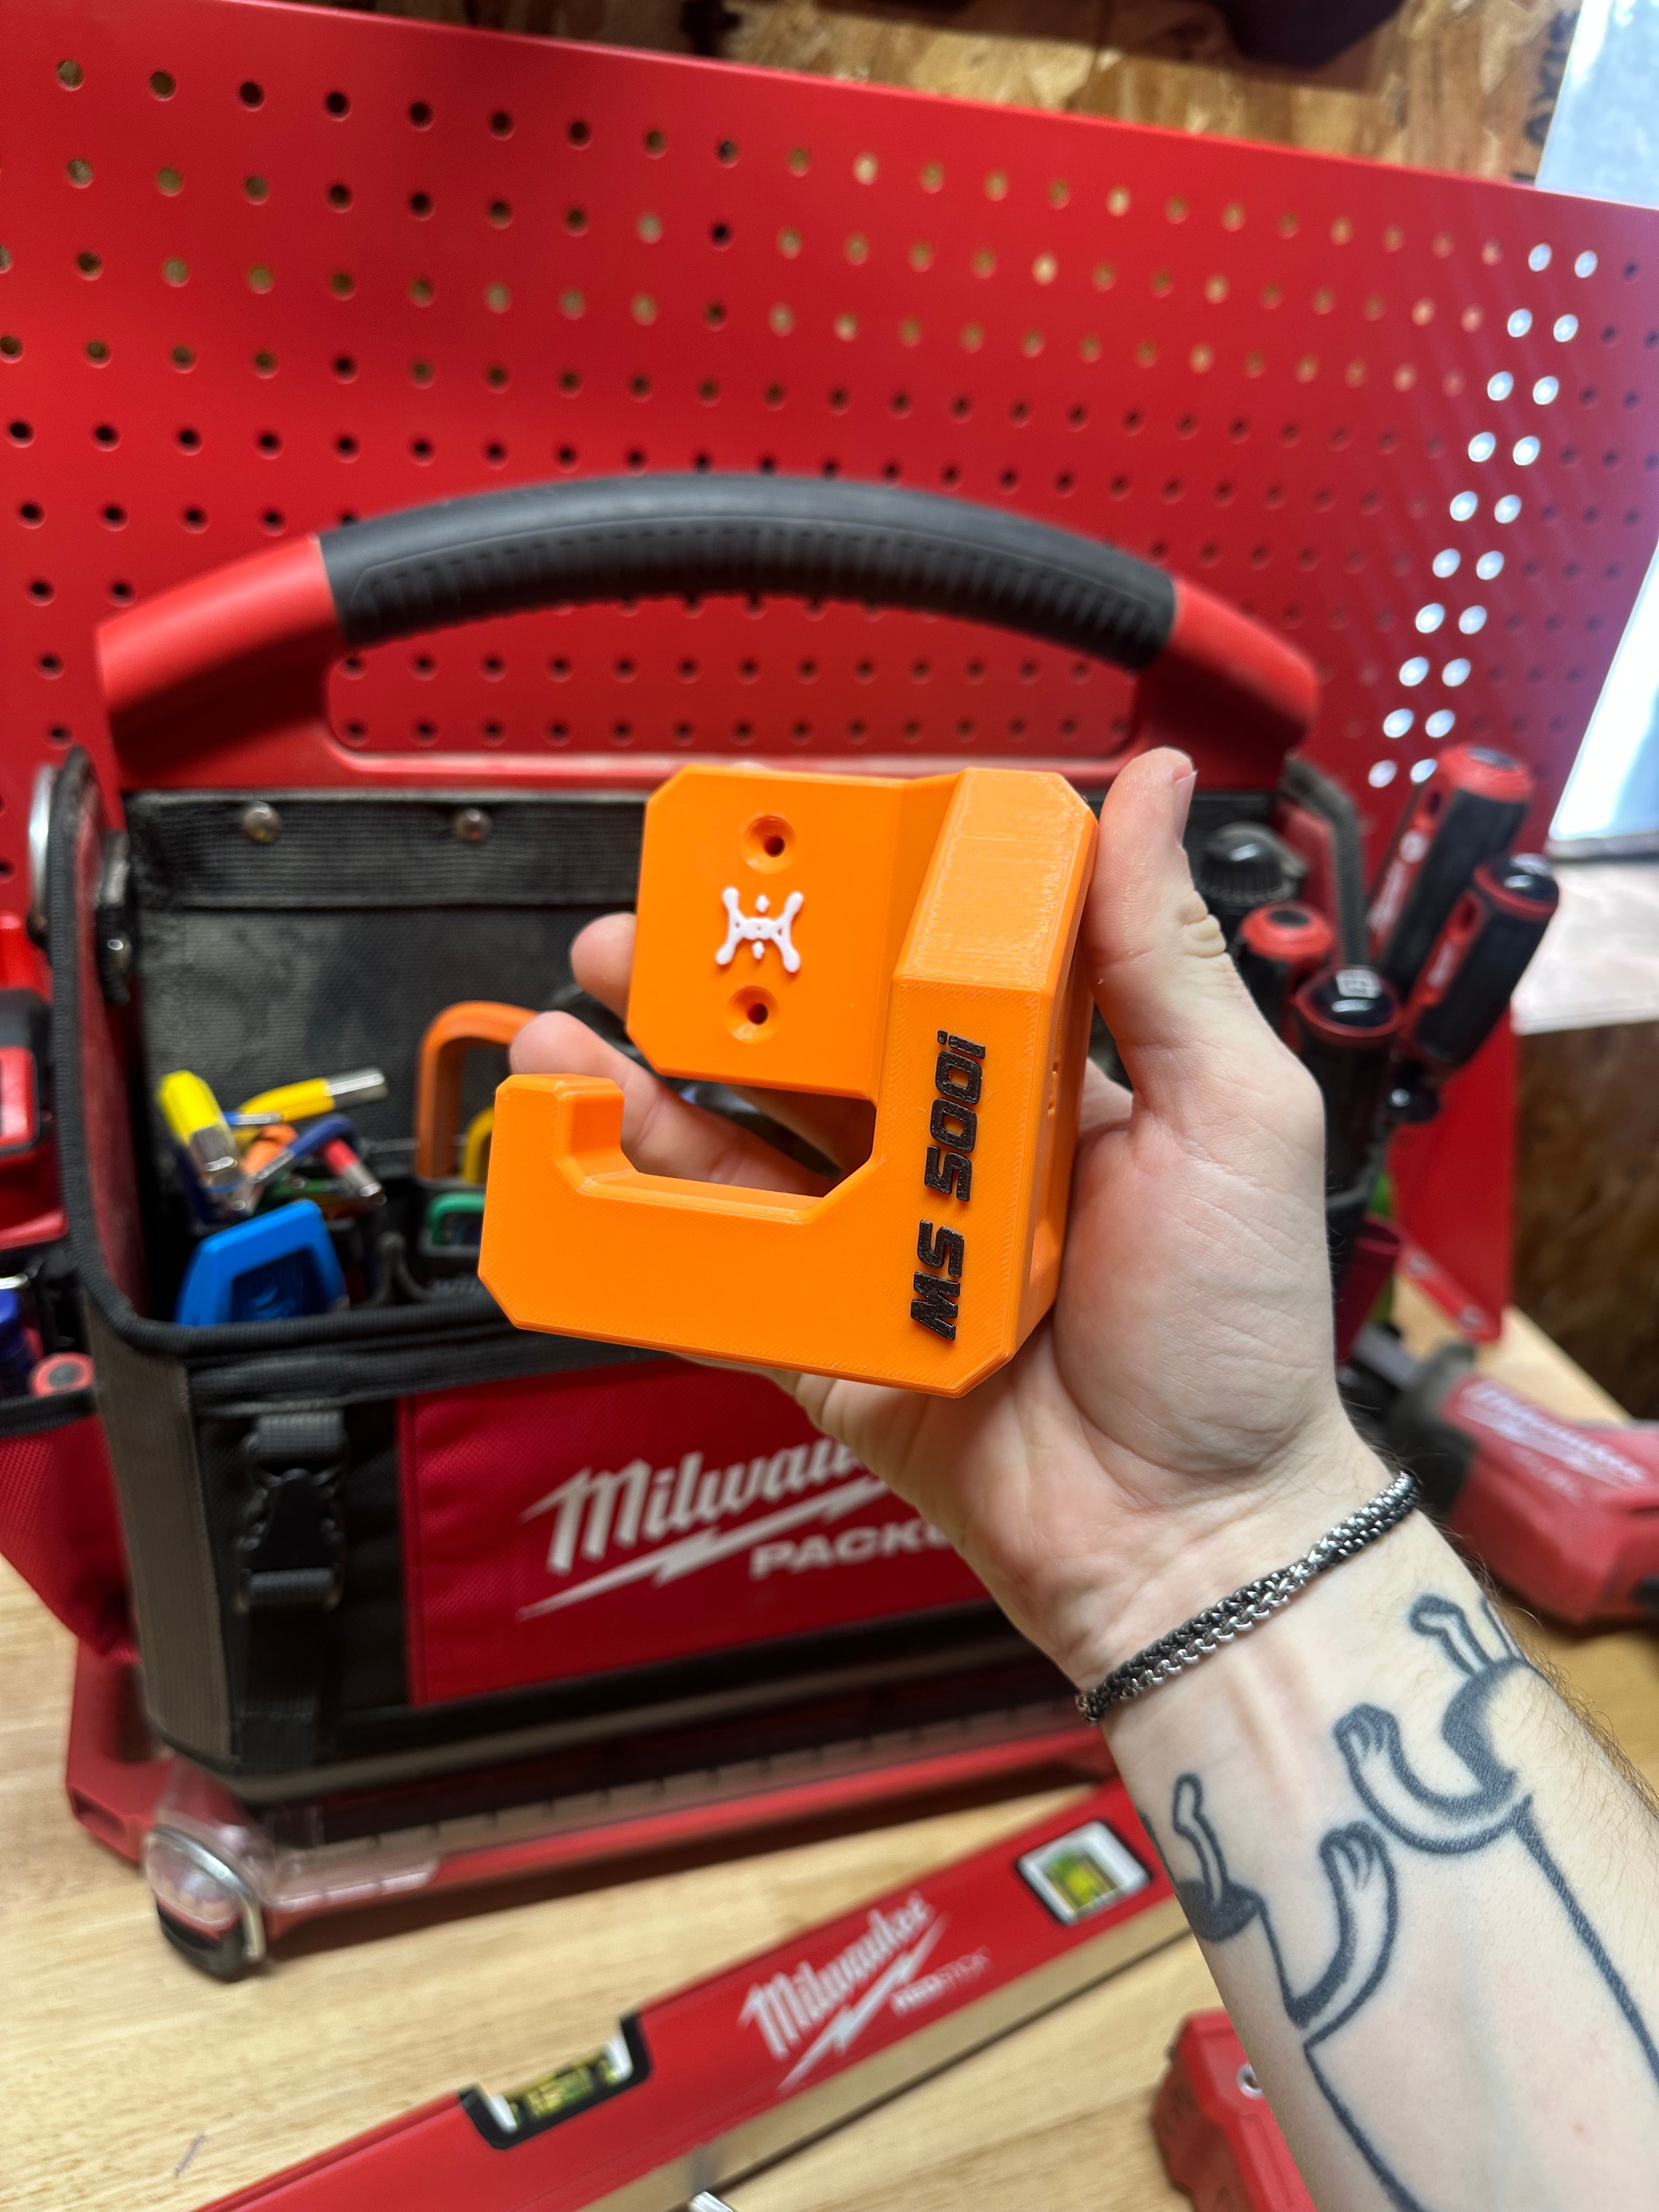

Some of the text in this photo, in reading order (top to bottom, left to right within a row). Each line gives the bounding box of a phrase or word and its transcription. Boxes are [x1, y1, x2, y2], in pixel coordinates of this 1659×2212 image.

[910, 1029, 986, 1341] MS 500i
[521, 1437, 870, 1575] Milwau
[749, 1517, 952, 1579] PACK
